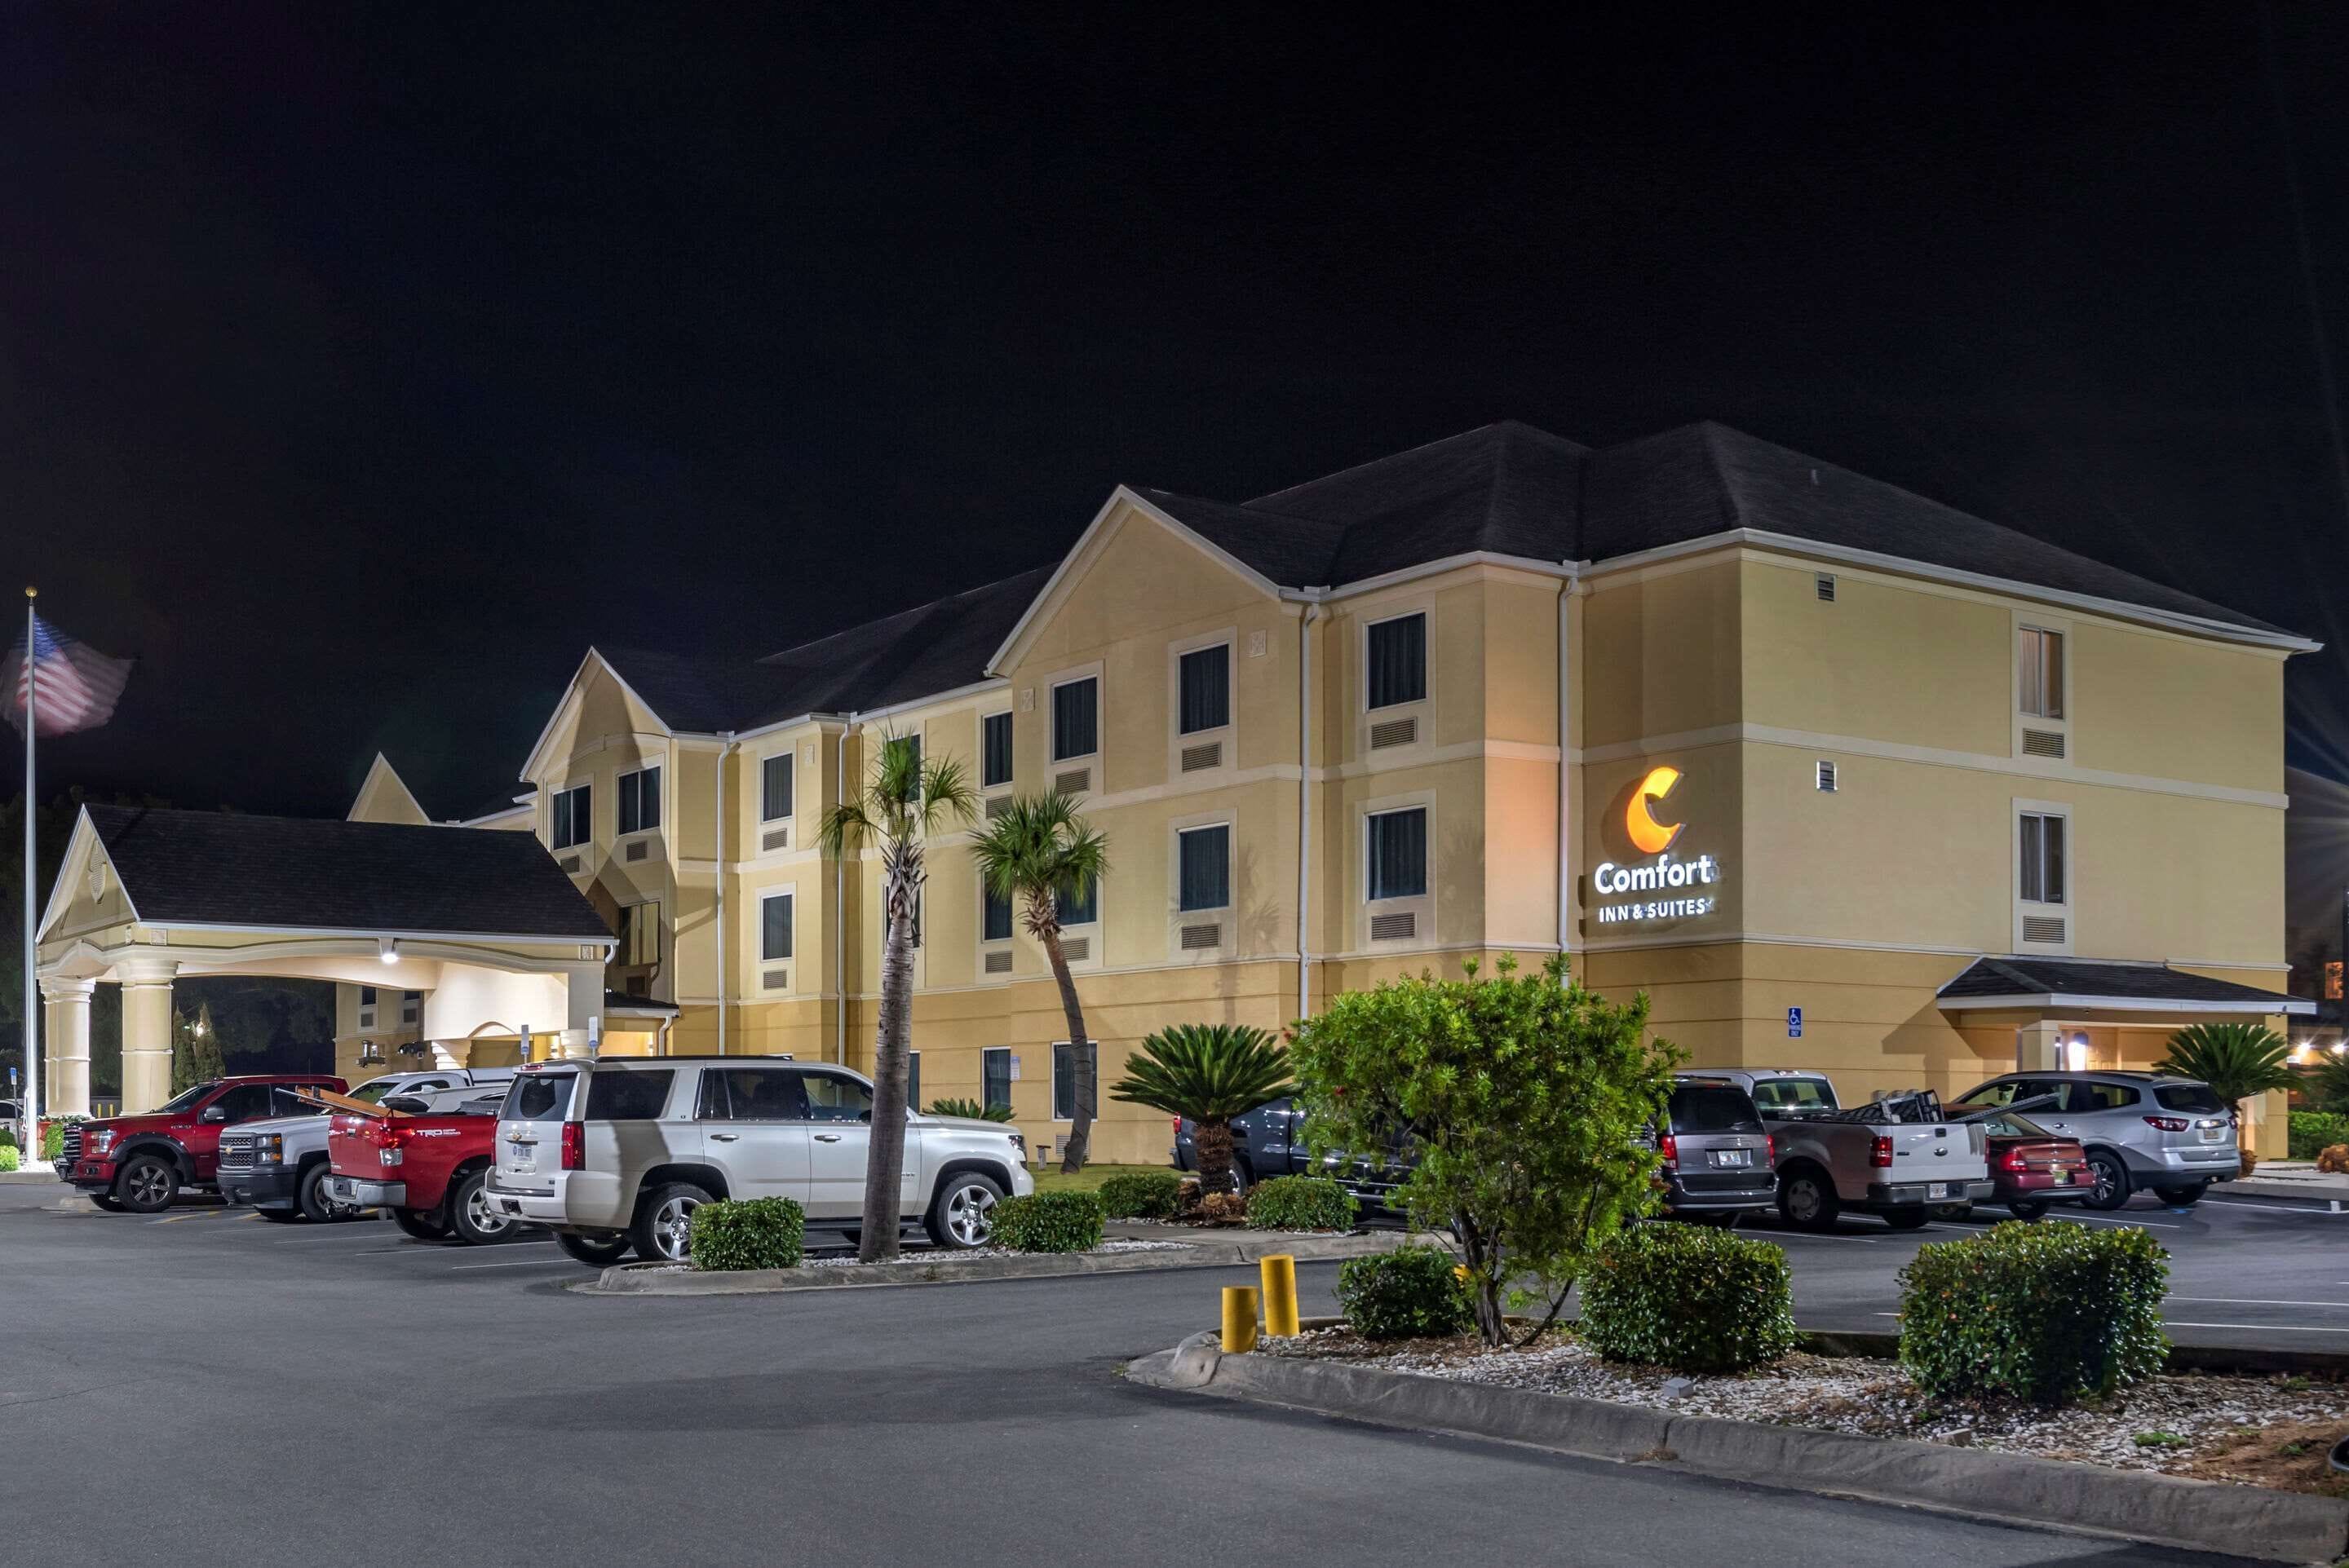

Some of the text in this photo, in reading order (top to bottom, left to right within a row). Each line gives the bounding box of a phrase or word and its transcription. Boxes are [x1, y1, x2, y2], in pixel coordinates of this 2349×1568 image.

[1595, 854, 1712, 894] Comfort
[1599, 898, 1705, 922] INN & SUITES
